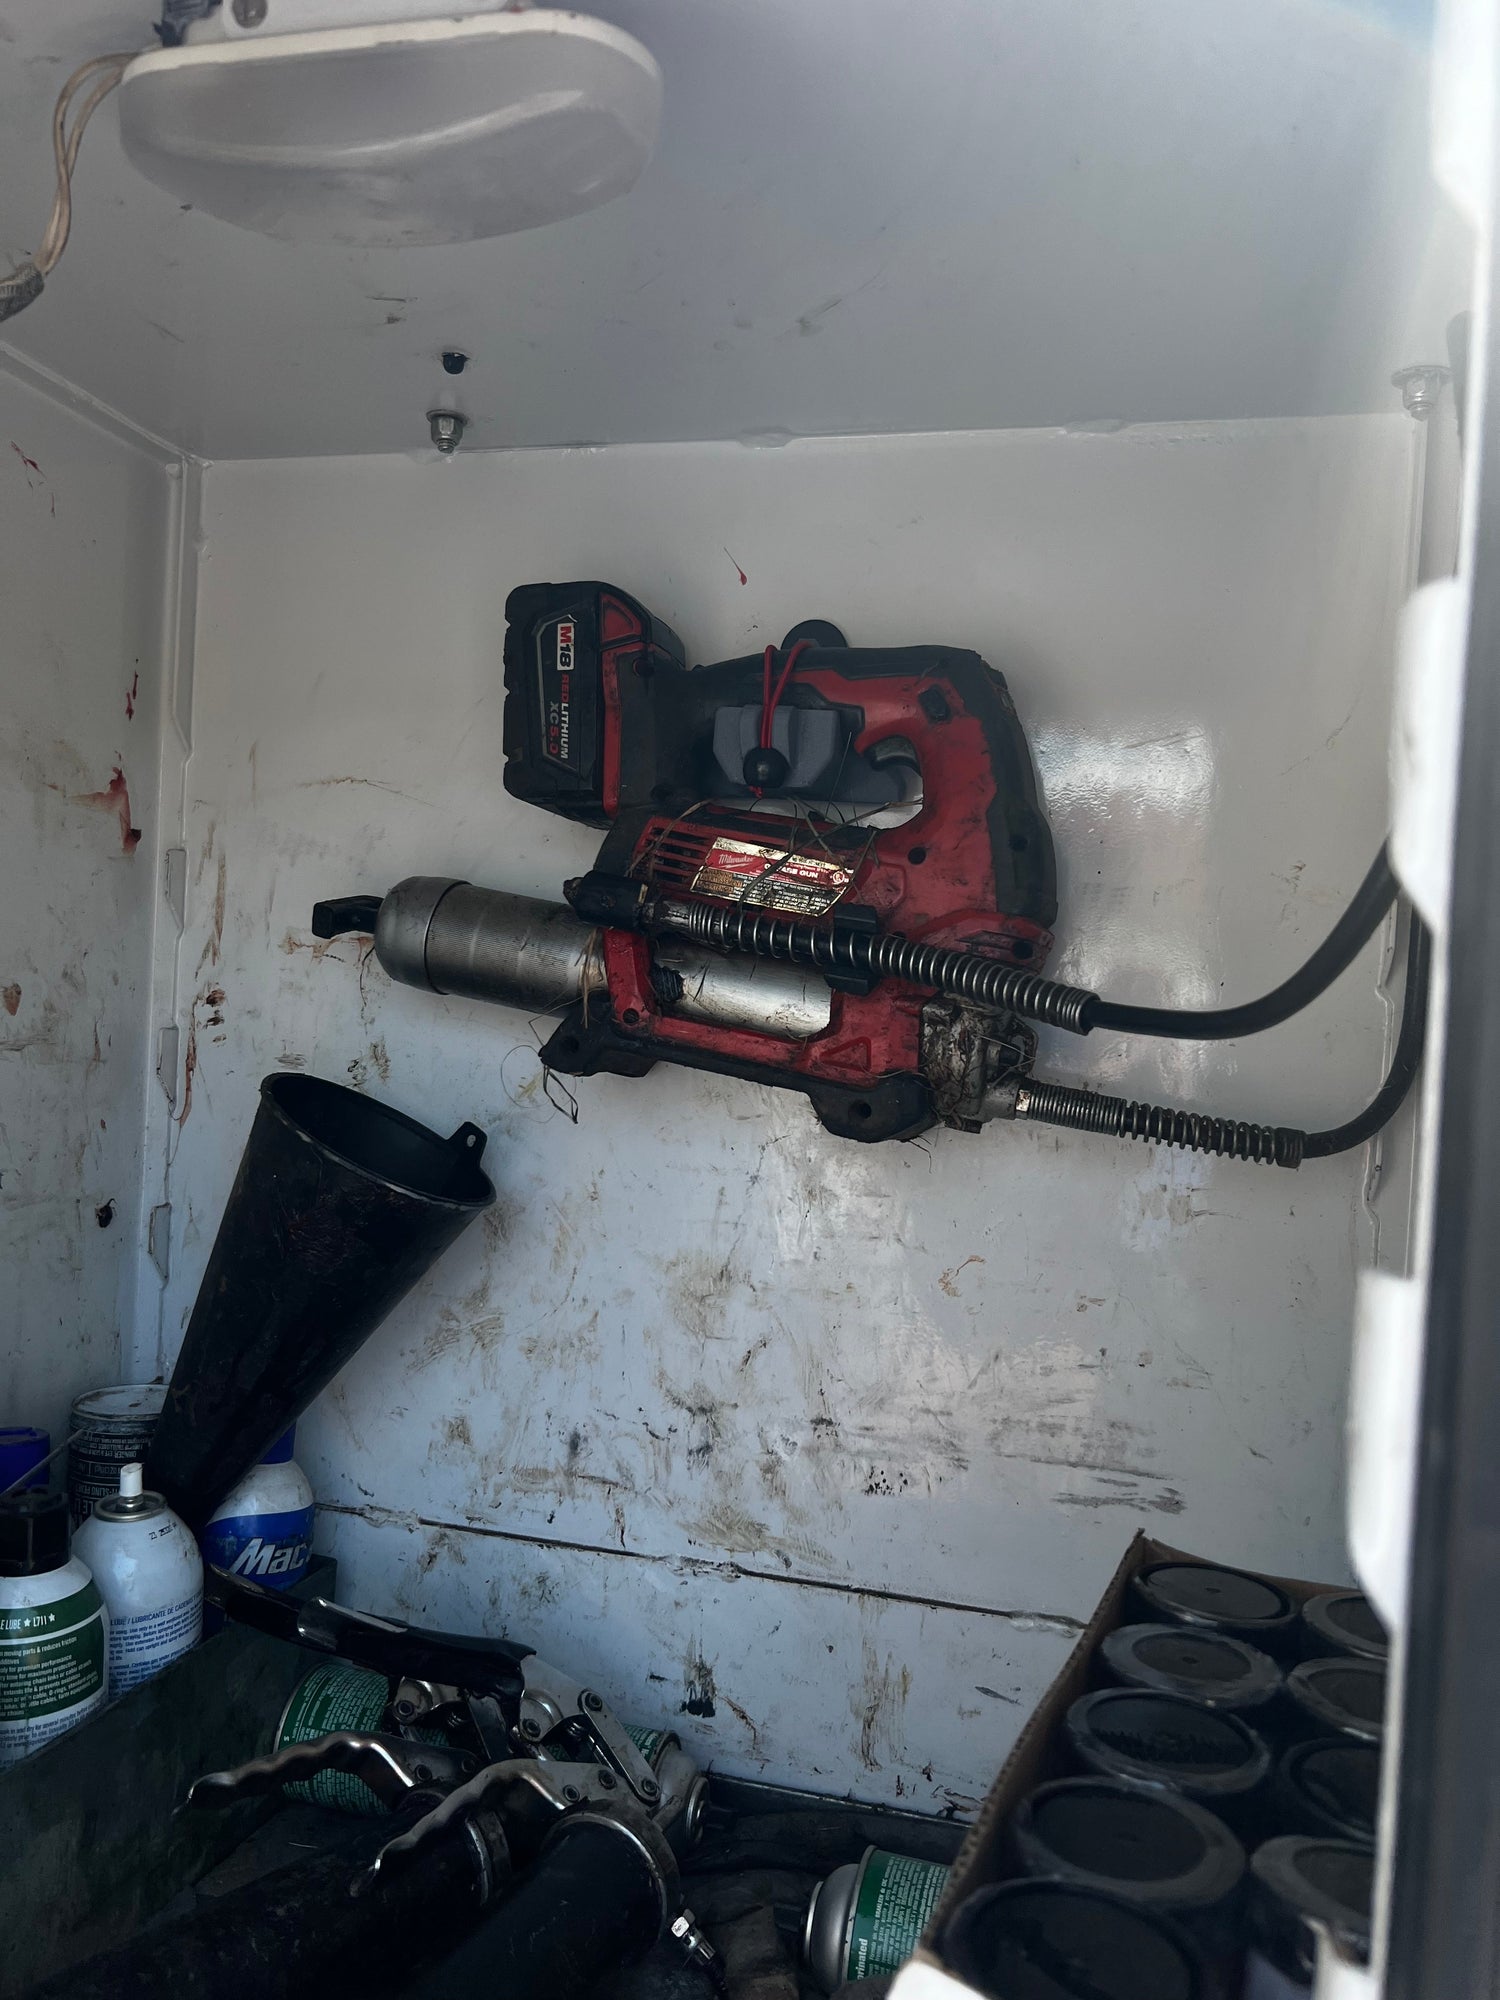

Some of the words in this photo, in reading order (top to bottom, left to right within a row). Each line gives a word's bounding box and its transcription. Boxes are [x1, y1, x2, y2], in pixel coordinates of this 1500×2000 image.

[559, 625, 573, 668] M18
[560, 673, 570, 759] REDLITHIUM
[764, 863, 798, 875] GASE
[799, 870, 818, 879] GUN
[229, 1537, 311, 1575] Mac
[5, 1618, 22, 1630] LUBE
[33, 1615, 48, 1627] L711
[110, 1618, 127, 1626] LUBE
[131, 1611, 166, 1625] LUBRICANTE
[167, 1606, 174, 1614] DE
